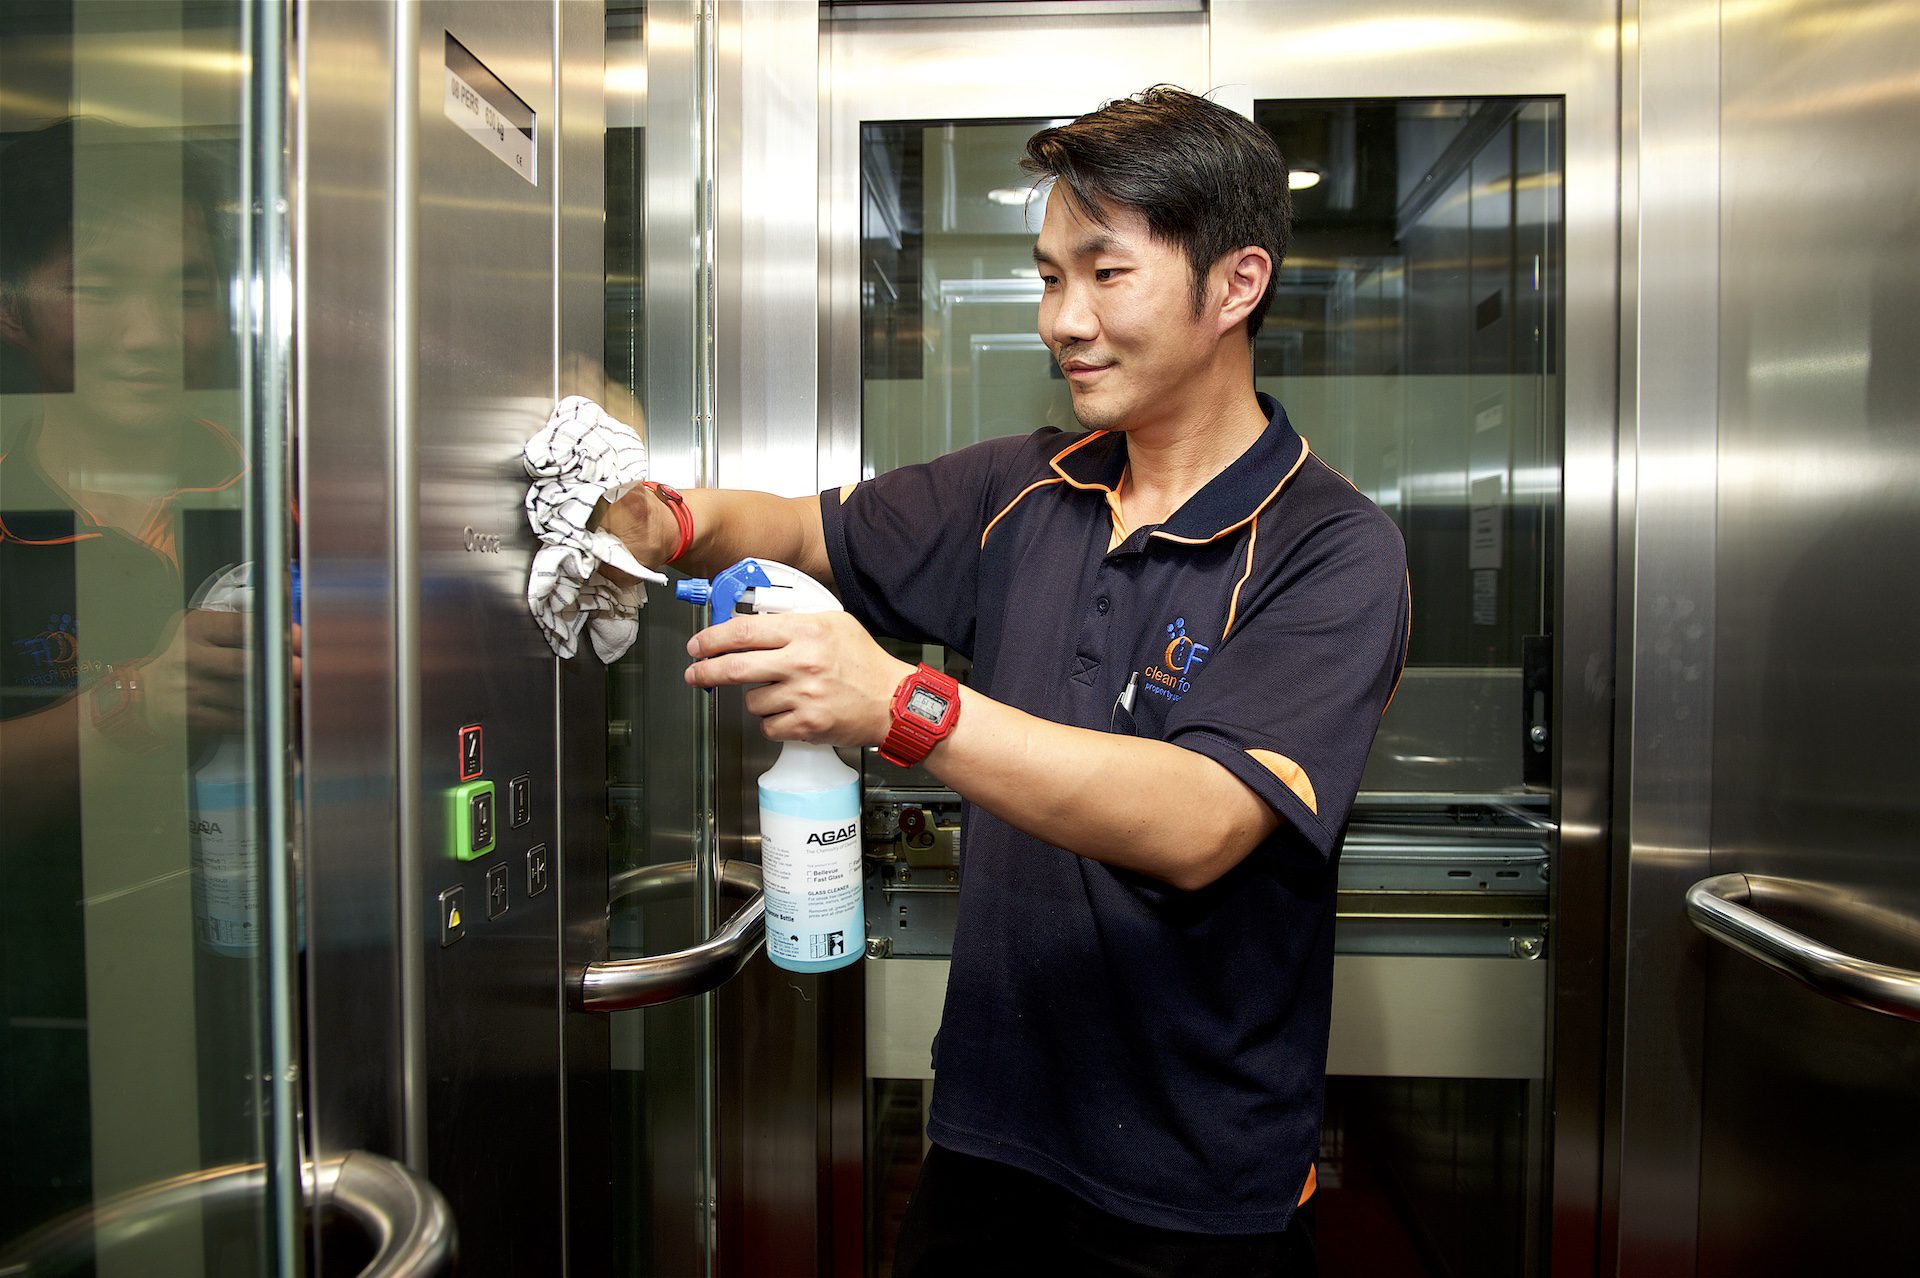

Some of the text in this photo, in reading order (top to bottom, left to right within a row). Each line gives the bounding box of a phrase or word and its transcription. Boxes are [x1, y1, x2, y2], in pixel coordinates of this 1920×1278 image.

[460, 86, 480, 116] PERS
[1145, 666, 1177, 688] clean
[806, 823, 856, 846] AGAR
[813, 868, 839, 876] Bellevue
[828, 873, 844, 881] Glass
[827, 884, 849, 894] CLEANER
